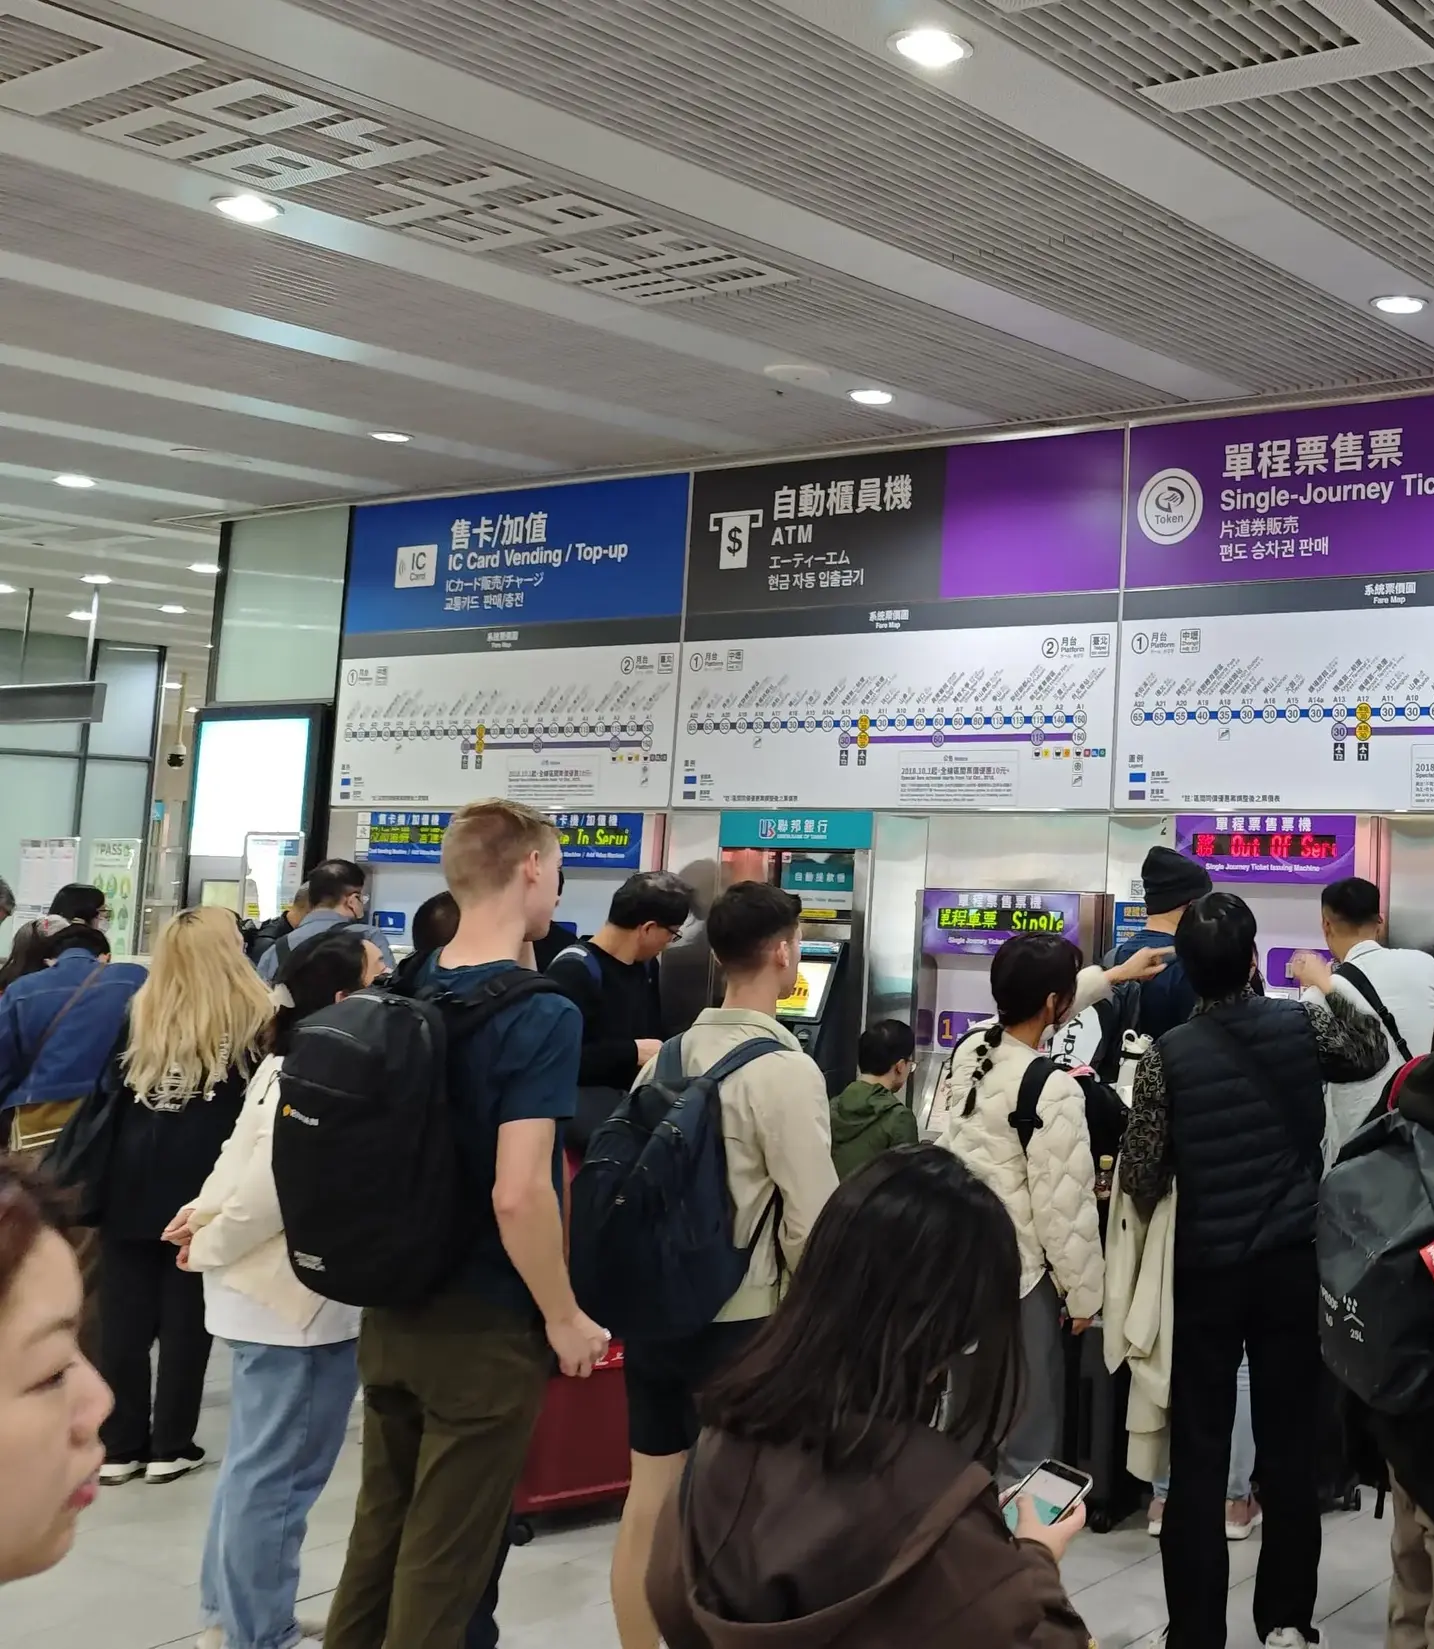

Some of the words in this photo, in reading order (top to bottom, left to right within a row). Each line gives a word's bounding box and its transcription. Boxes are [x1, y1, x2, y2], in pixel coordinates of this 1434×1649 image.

[1222, 428, 1403, 482] 單程票售票
[773, 474, 912, 521] 自動櫃員機
[1220, 481, 1394, 514] Single-Journey
[1154, 513, 1184, 525] Token
[1219, 516, 1299, 539] 片道券販売
[451, 511, 548, 550] 售卡/加值
[771, 524, 813, 545] ATM
[448, 554, 463, 571] IC
[467, 550, 500, 569] Card
[504, 547, 562, 567] Vending
[575, 542, 628, 564] Top-up
[769, 550, 850, 569] エーティーエム
[1219, 542, 1248, 562] 편도
[1251, 539, 1295, 559] 승차권
[1299, 536, 1329, 556] 판매
[411, 552, 426, 571] IC
[446, 572, 544, 593] ICカード販売/チャージ
[768, 574, 790, 590] 현금
[793, 572, 816, 589] 자동
[819, 568, 864, 588] 입출금기
[1373, 596, 1389, 604] Fare
[1391, 595, 1406, 604] Map
[777, 819, 828, 834] 聯邦銀行
[1216, 817, 1312, 832] 單程票售票機
[577, 829, 589, 845] In
[1230, 835, 1260, 857] Out
[1270, 835, 1293, 858] Of
[1012, 911, 1064, 932] Single
[941, 1020, 952, 1040] 1
